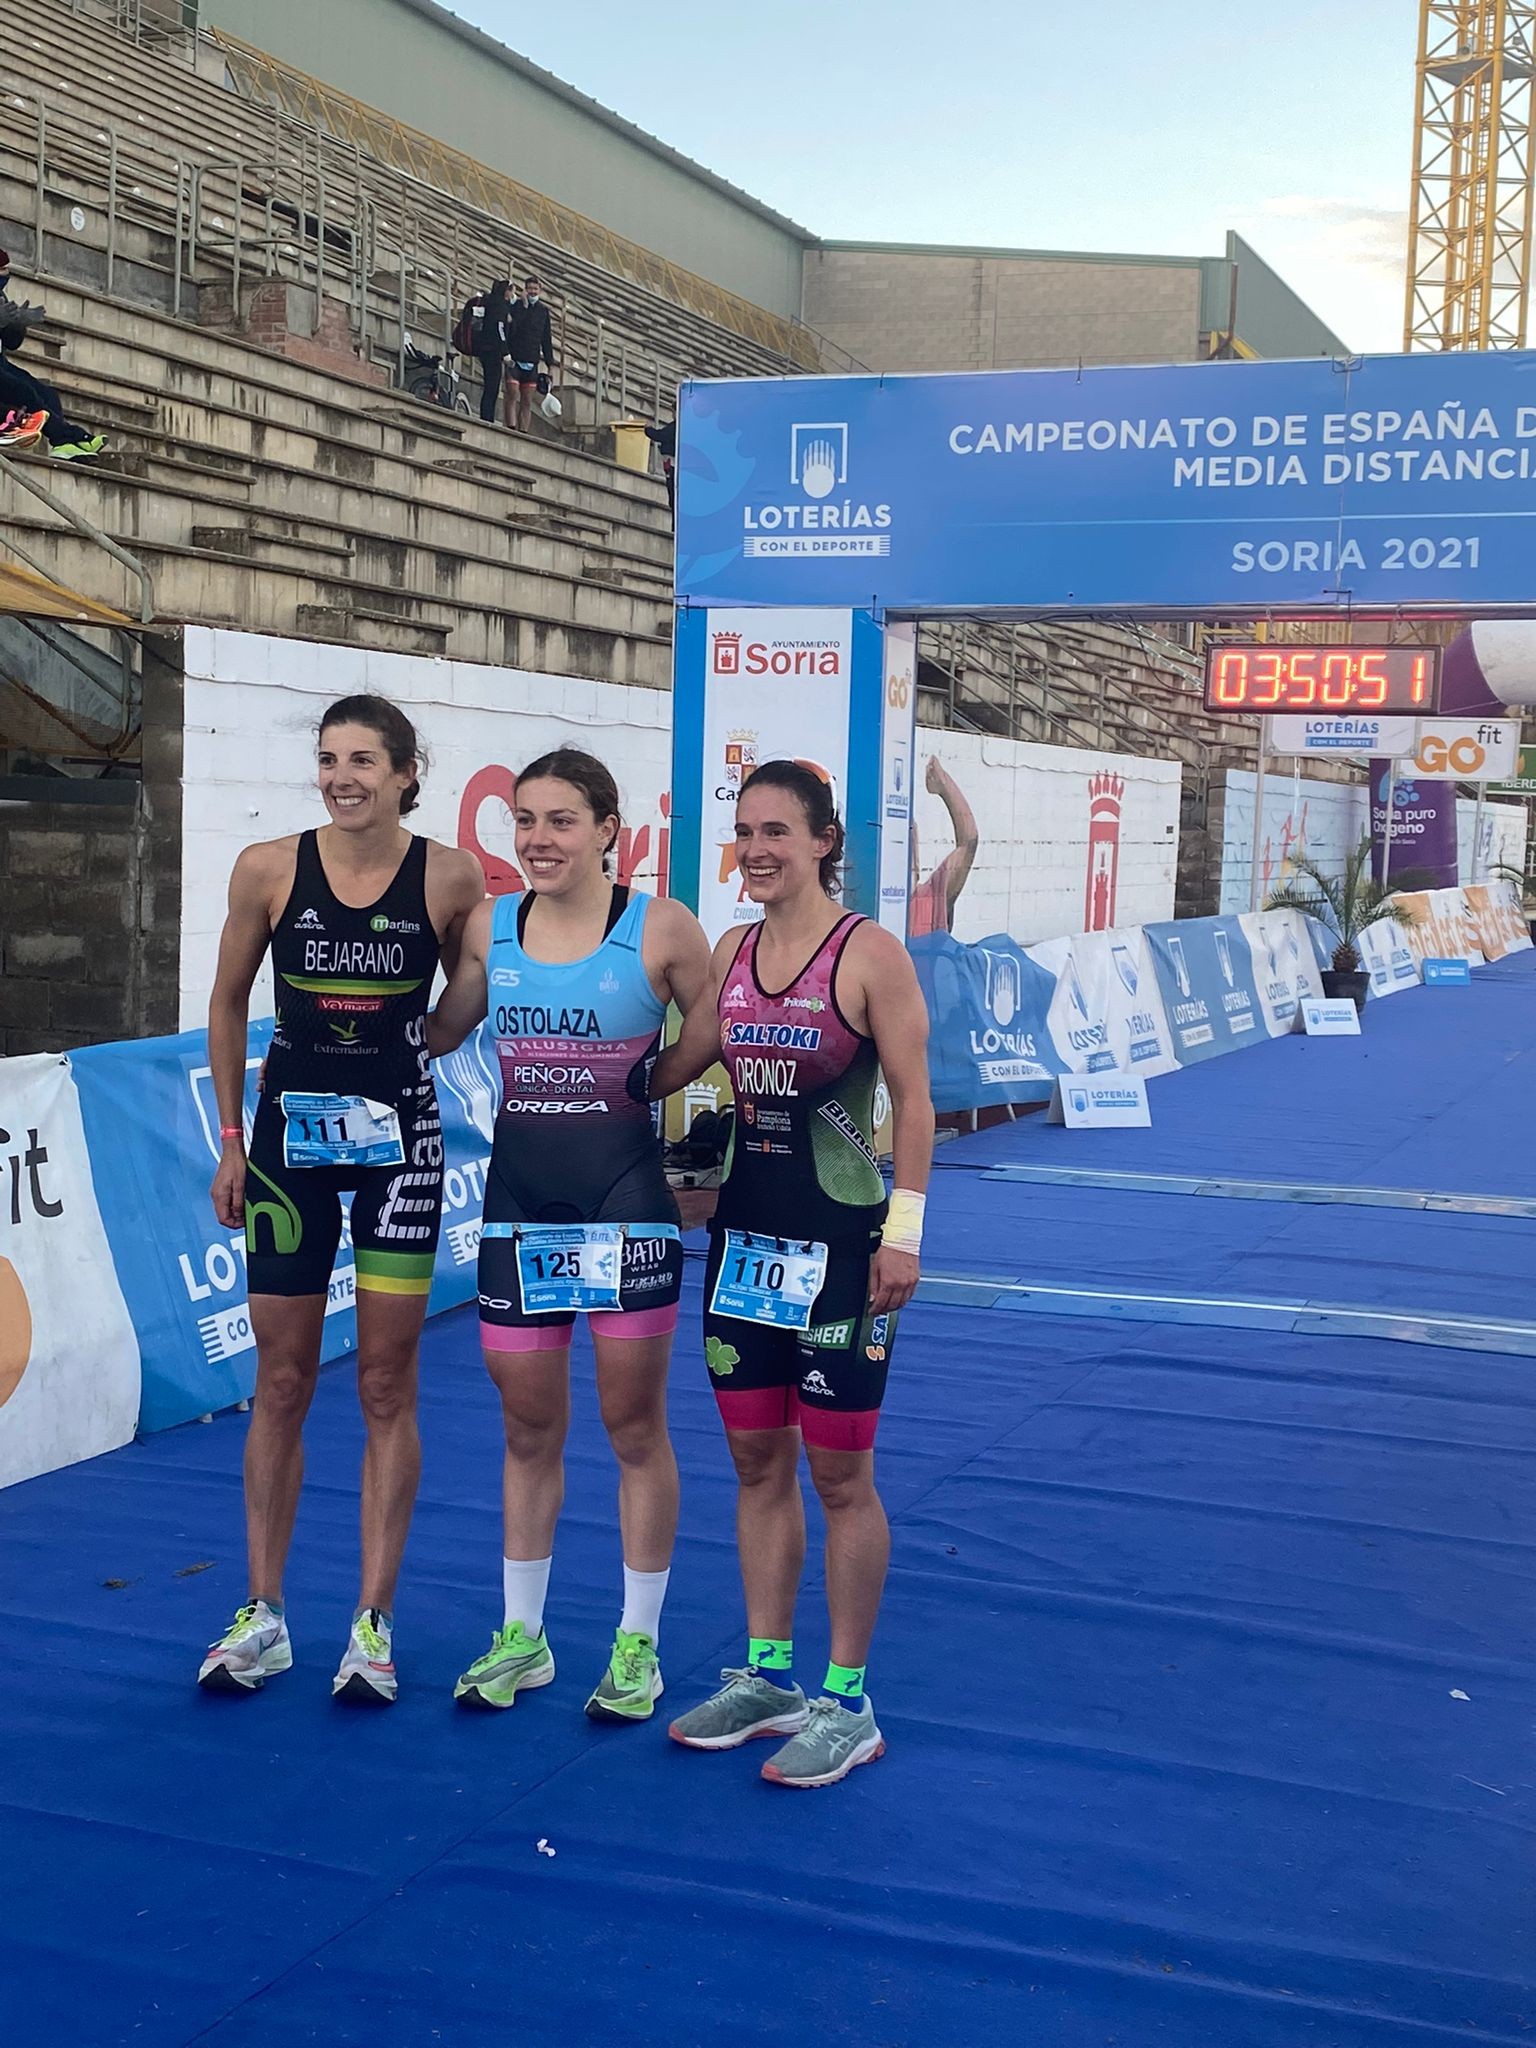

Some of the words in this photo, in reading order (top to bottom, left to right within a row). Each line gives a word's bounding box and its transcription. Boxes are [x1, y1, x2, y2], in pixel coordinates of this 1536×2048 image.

[949, 416, 1237, 455] CAMPEONATO
[1252, 415, 1307, 446] DE
[1323, 400, 1500, 444] ESPAÑA
[1174, 454, 1308, 487] MEDIA
[1323, 447, 1536, 485] DISTANCI
[743, 499, 892, 529] LOTERÍAS
[760, 541, 789, 552] CON
[793, 541, 808, 551] EL
[812, 540, 874, 551] DEPORTE
[1231, 539, 1367, 573] SORIA
[1381, 537, 1480, 570] 2021
[771, 640, 840, 649] AYUNTAMIENTO
[745, 643, 839, 675] Soria
[1305, 720, 1380, 734] LOTERÍAS
[1477, 725, 1502, 745] fit
[1414, 736, 1486, 774] GO
[1373, 806, 1402, 820] Soa
[1405, 809, 1436, 823] puro
[1373, 821, 1425, 837] Oxgeno
[304, 940, 404, 975] BEJARANO
[496, 1005, 602, 1038] OSTOLAZA
[521, 1040, 628, 1052] ALUSIGMA
[729, 1022, 821, 1051] SALTOKI
[314, 1043, 379, 1055] Extremadura
[514, 1062, 597, 1084] PEÑOTA
[735, 1056, 798, 1096] ORONOZ
[992, 1066, 1011, 1076] CON
[1012, 1066, 1020, 1076] EL
[555, 1085, 594, 1093] DENTAL
[1091, 1089, 1139, 1099] LOTERÍAS
[506, 1100, 609, 1113] ORBEA
[299, 1117, 348, 1142] 111
[530, 1252, 580, 1279] 125
[631, 1263, 659, 1272] WEAR
[735, 1256, 785, 1290] 110
